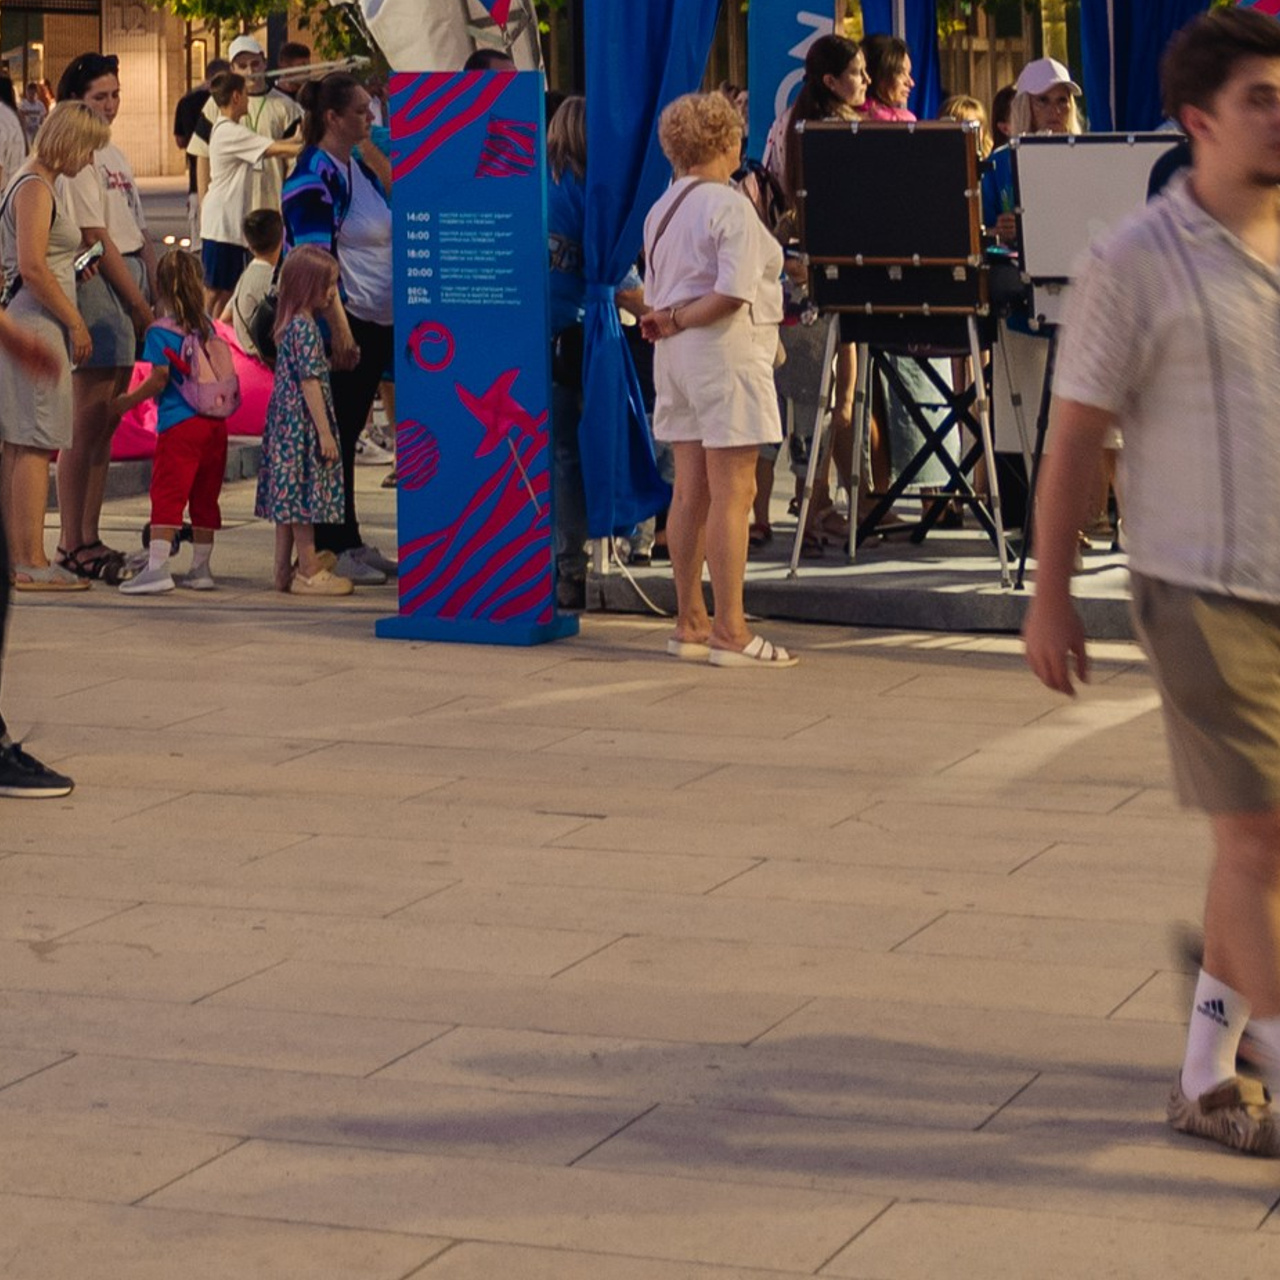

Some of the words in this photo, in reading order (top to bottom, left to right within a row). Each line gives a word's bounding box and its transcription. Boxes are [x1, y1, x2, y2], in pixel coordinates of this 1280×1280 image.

[406, 212, 430, 222] 14:00
[406, 230, 430, 241] 16:00
[406, 248, 431, 259] 18:00
[407, 266, 433, 277] 20:00
